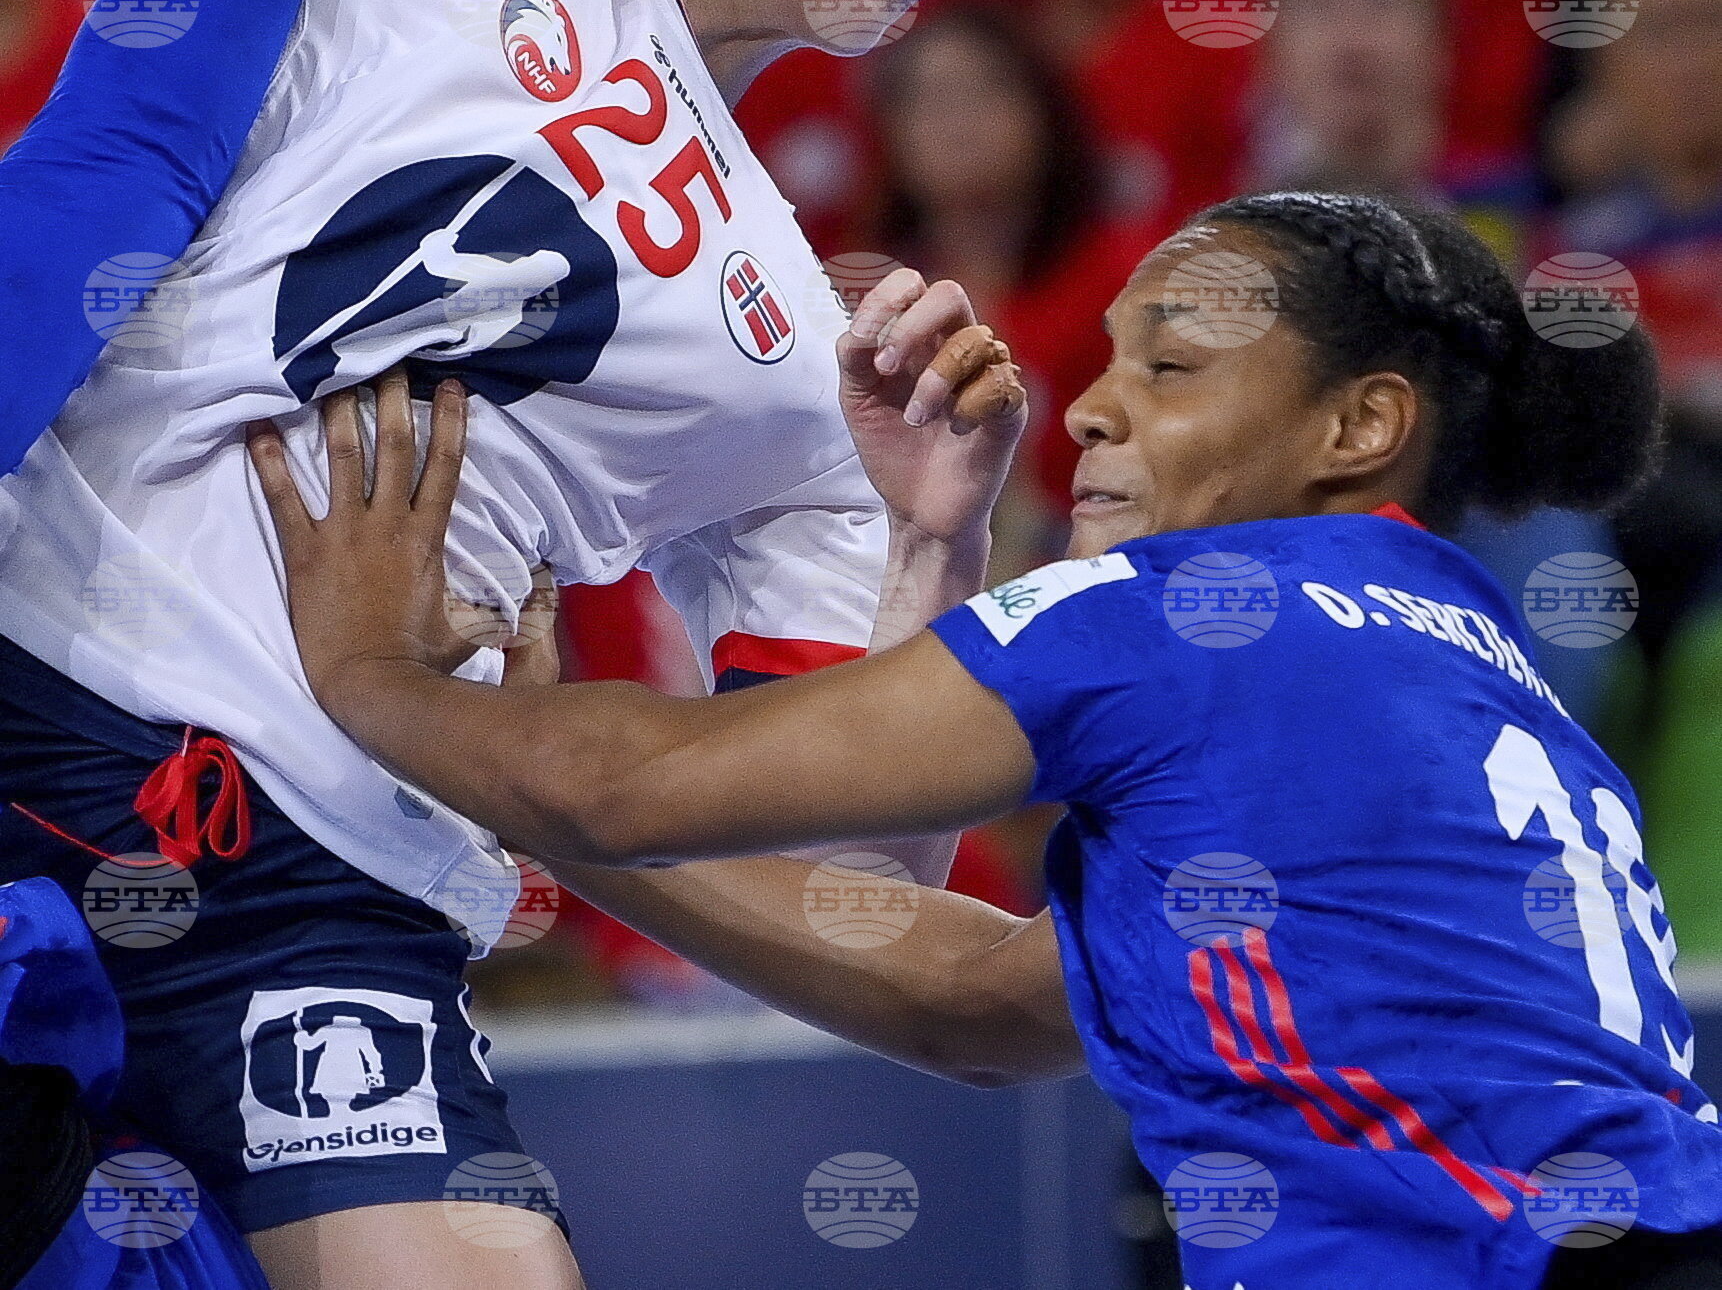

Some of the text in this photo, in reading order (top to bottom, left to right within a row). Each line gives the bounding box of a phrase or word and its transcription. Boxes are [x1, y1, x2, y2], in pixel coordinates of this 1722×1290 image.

[518, 51, 556, 94] NHF
[668, 67, 731, 179] hummel
[536, 58, 732, 278] 25
[247, 1122, 438, 1163] Gjensidige
